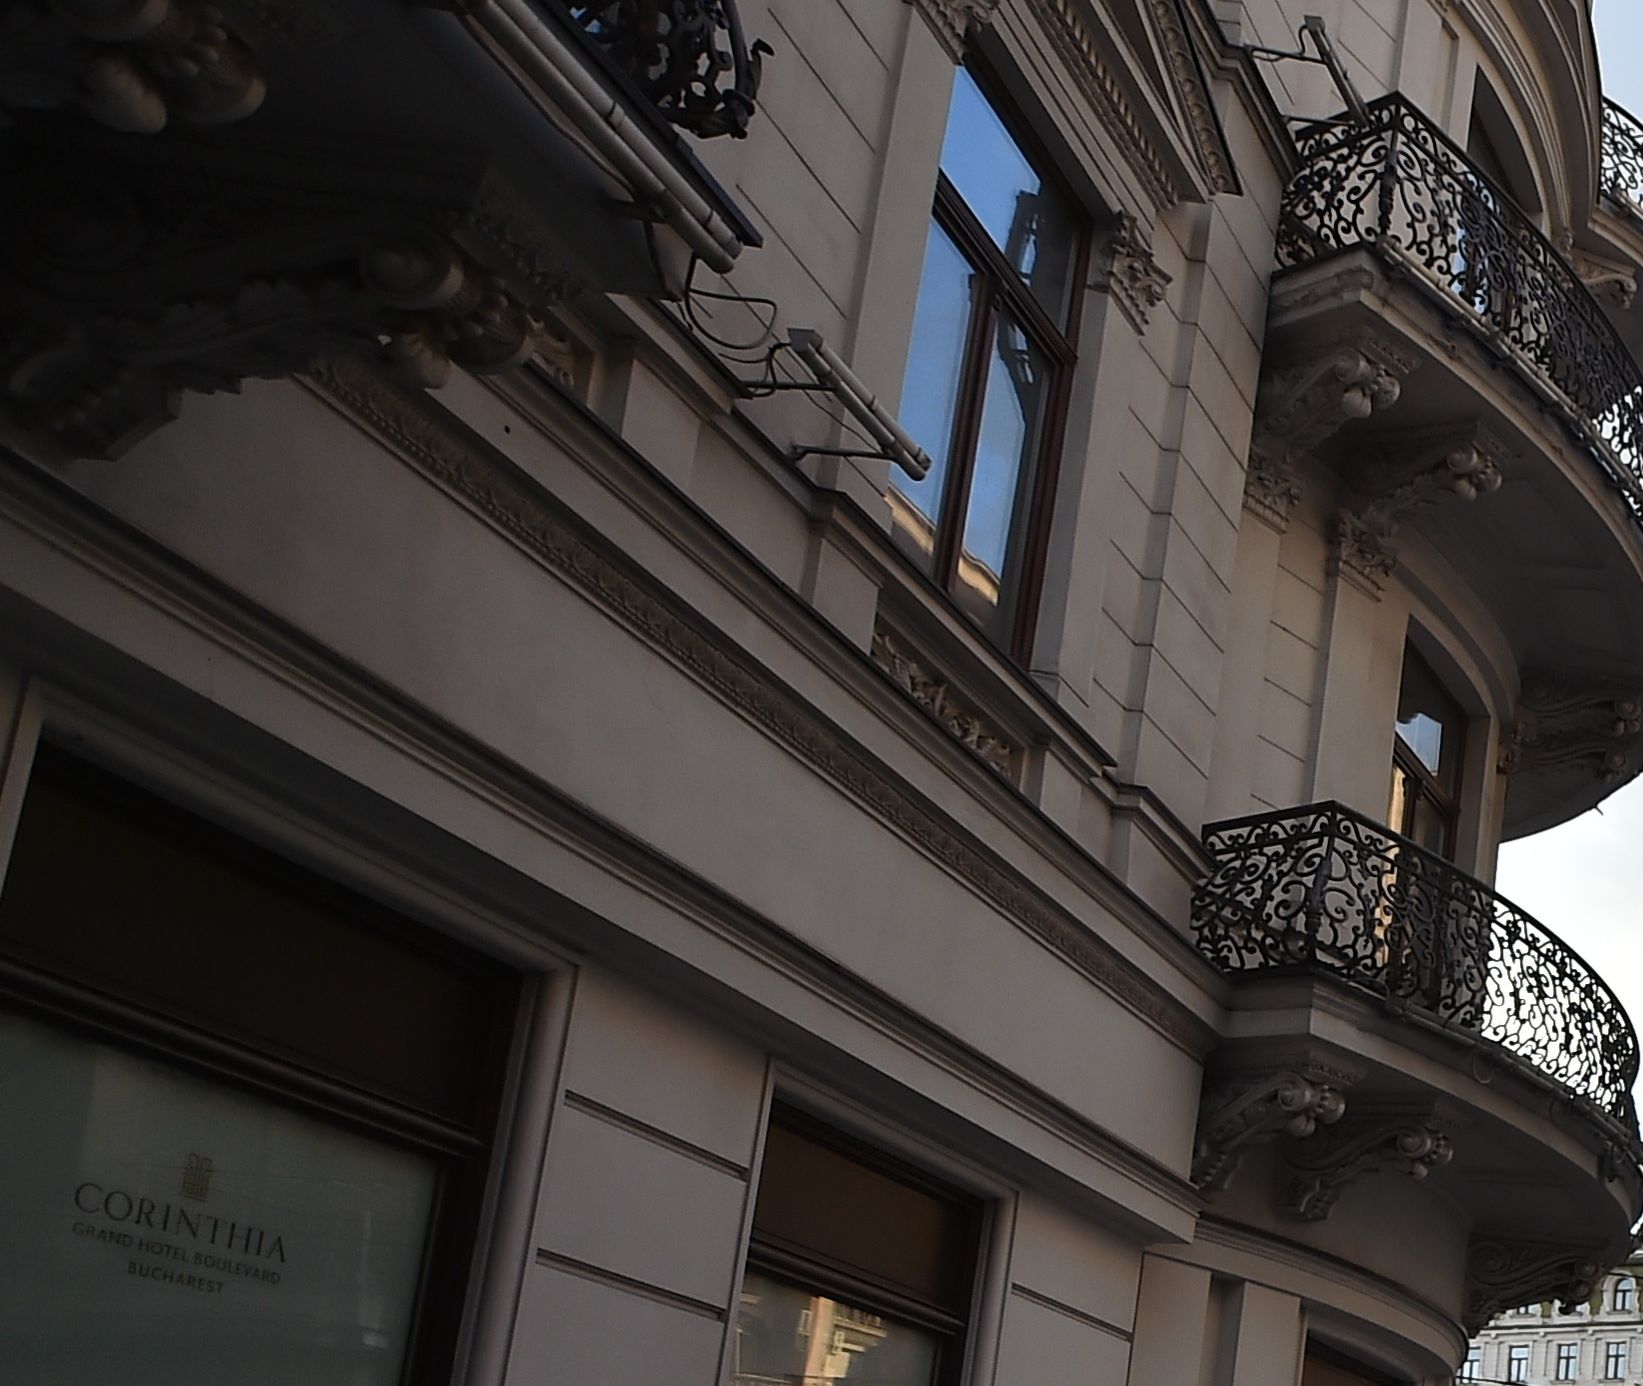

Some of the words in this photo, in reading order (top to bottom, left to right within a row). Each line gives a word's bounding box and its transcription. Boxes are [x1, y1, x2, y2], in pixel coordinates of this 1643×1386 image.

[73, 1222, 133, 1248] GRAND
[138, 1239, 188, 1263] HOTEL
[194, 1252, 280, 1284] BOULEVARD
[75, 1183, 286, 1263] CORINTHIA
[128, 1262, 224, 1293] BUCHAREST
